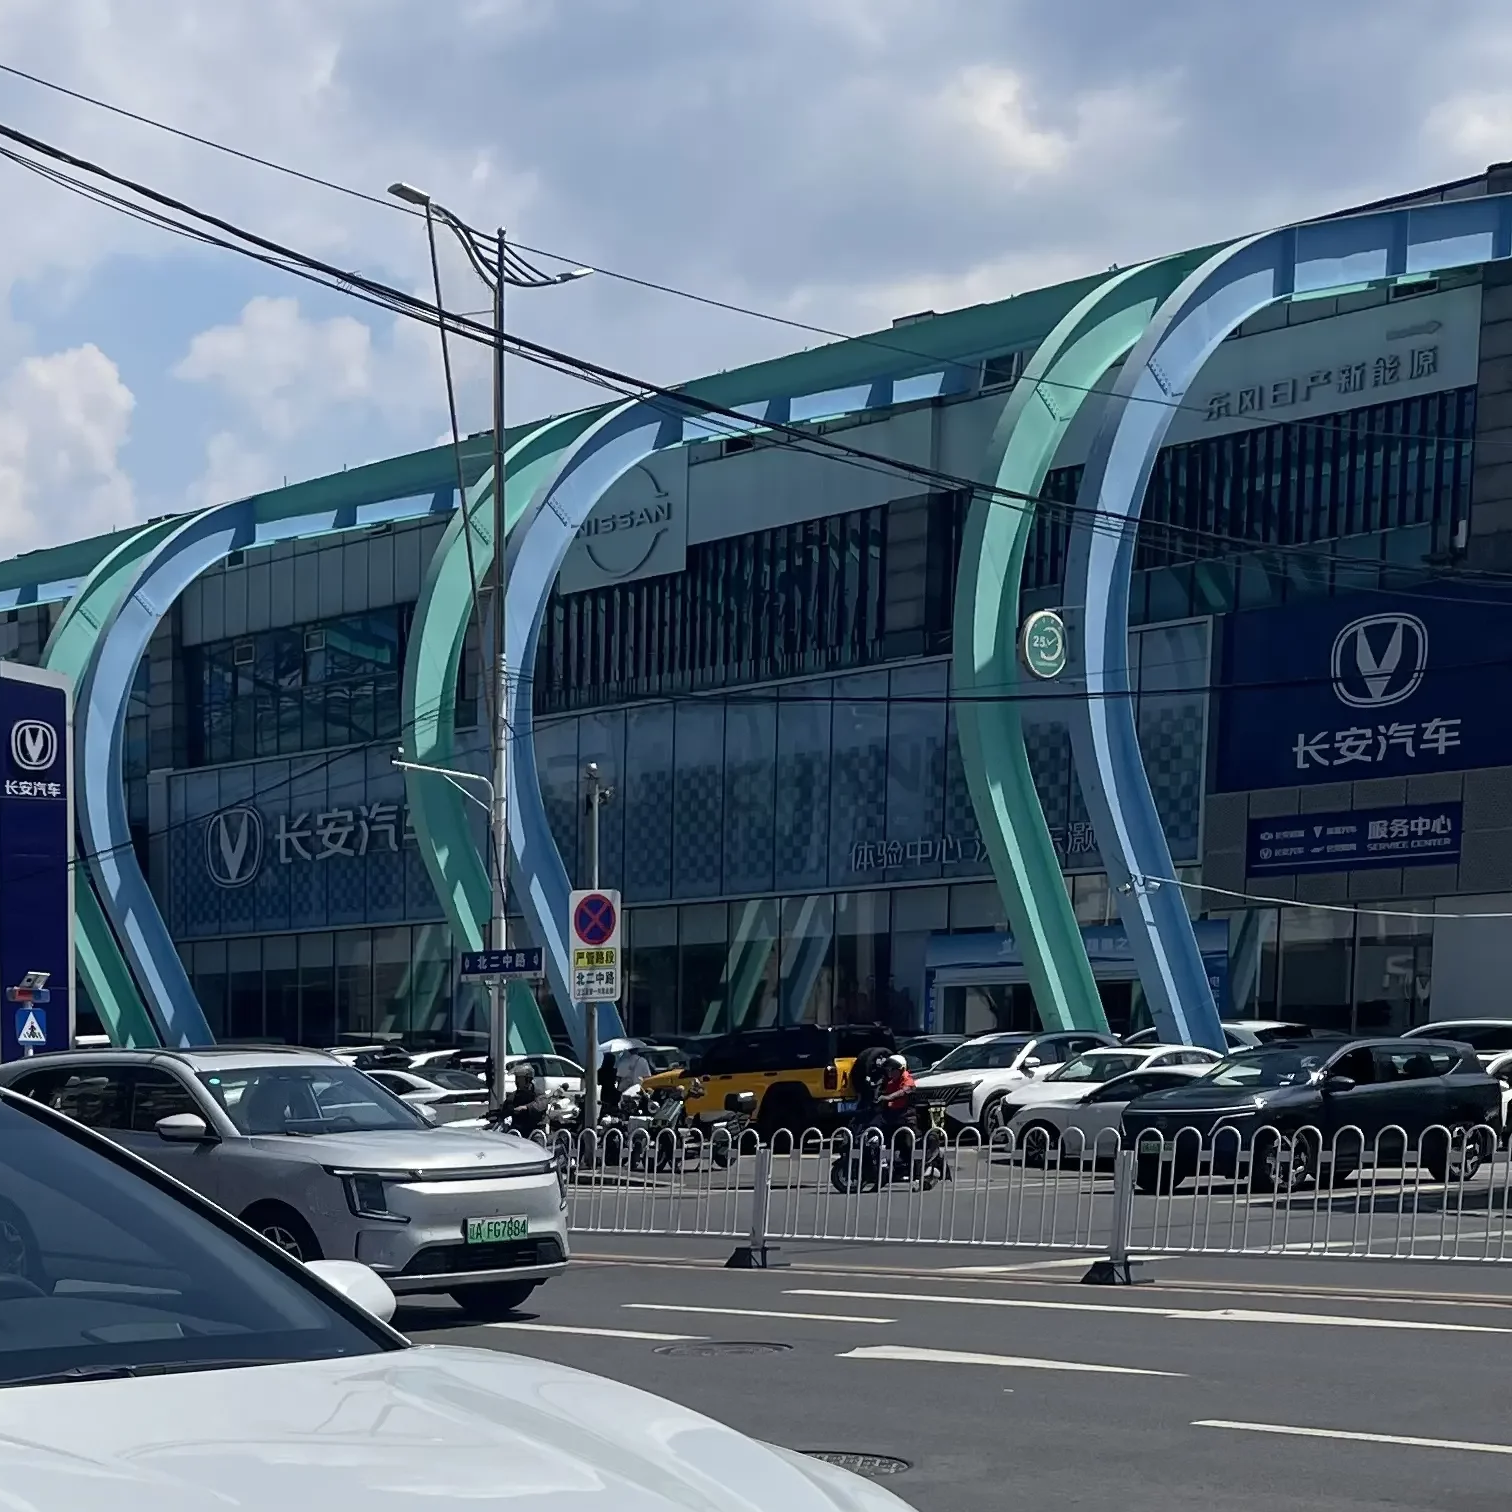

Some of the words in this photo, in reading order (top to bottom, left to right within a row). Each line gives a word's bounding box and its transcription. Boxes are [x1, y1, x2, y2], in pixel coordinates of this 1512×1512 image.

[1203, 345, 1439, 422] 东风日产新能源
[575, 502, 672, 539] NISSAN
[1292, 717, 1462, 769] 长安汽车
[4, 779, 62, 798] 长安汽车
[1367, 814, 1452, 840] 服务中心
[851, 834, 962, 873] 体验中心
[1366, 840, 1409, 852] SERVICE
[1410, 837, 1452, 848] CENTER
[477, 952, 526, 970] 北二中路
[576, 971, 615, 985] 北二中路
